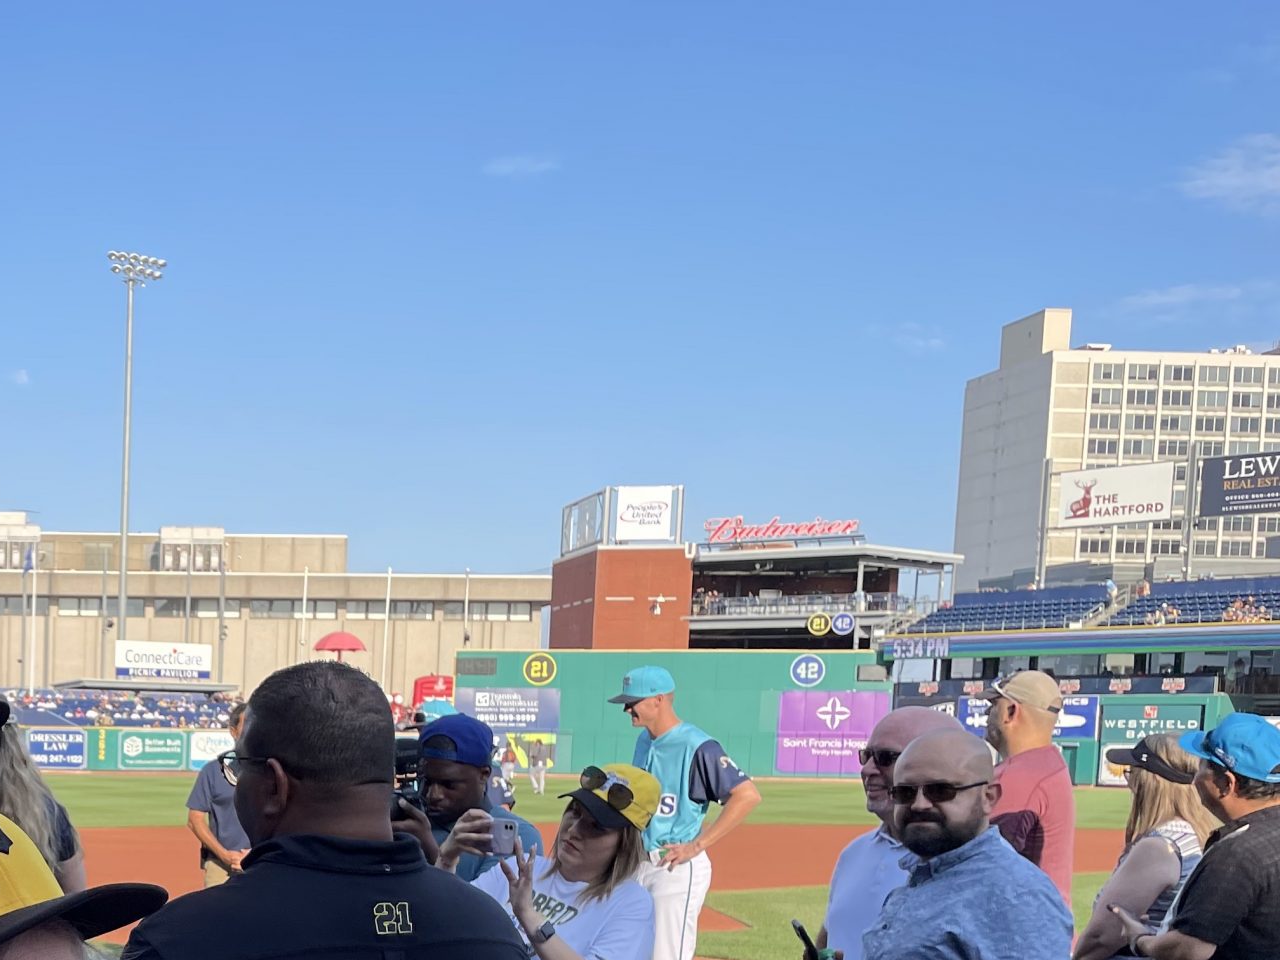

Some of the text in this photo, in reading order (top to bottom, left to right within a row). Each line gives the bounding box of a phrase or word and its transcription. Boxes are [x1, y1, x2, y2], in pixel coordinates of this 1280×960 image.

[1223, 479, 1255, 490] REAL
[1095, 493, 1118, 504] THE
[1093, 502, 1164, 518] HARTFORD
[704, 514, 860, 542] Budweiser
[812, 618, 826, 630] 21
[835, 617, 850, 629] 42
[893, 638, 950, 658] 5:34 PM
[125, 648, 203, 666] ConnectiCare
[129, 668, 199, 679] PICNIC PAVILION
[530, 661, 548, 678] 21
[796, 661, 819, 679] 42
[1104, 719, 1198, 729] WESTFIELD
[30, 733, 83, 743] DRESSLER
[783, 738, 807, 748] Saint
[808, 738, 843, 748] Francis
[43, 742, 69, 751] LAW
[660, 795, 676, 815] S
[373, 901, 413, 935] 21
